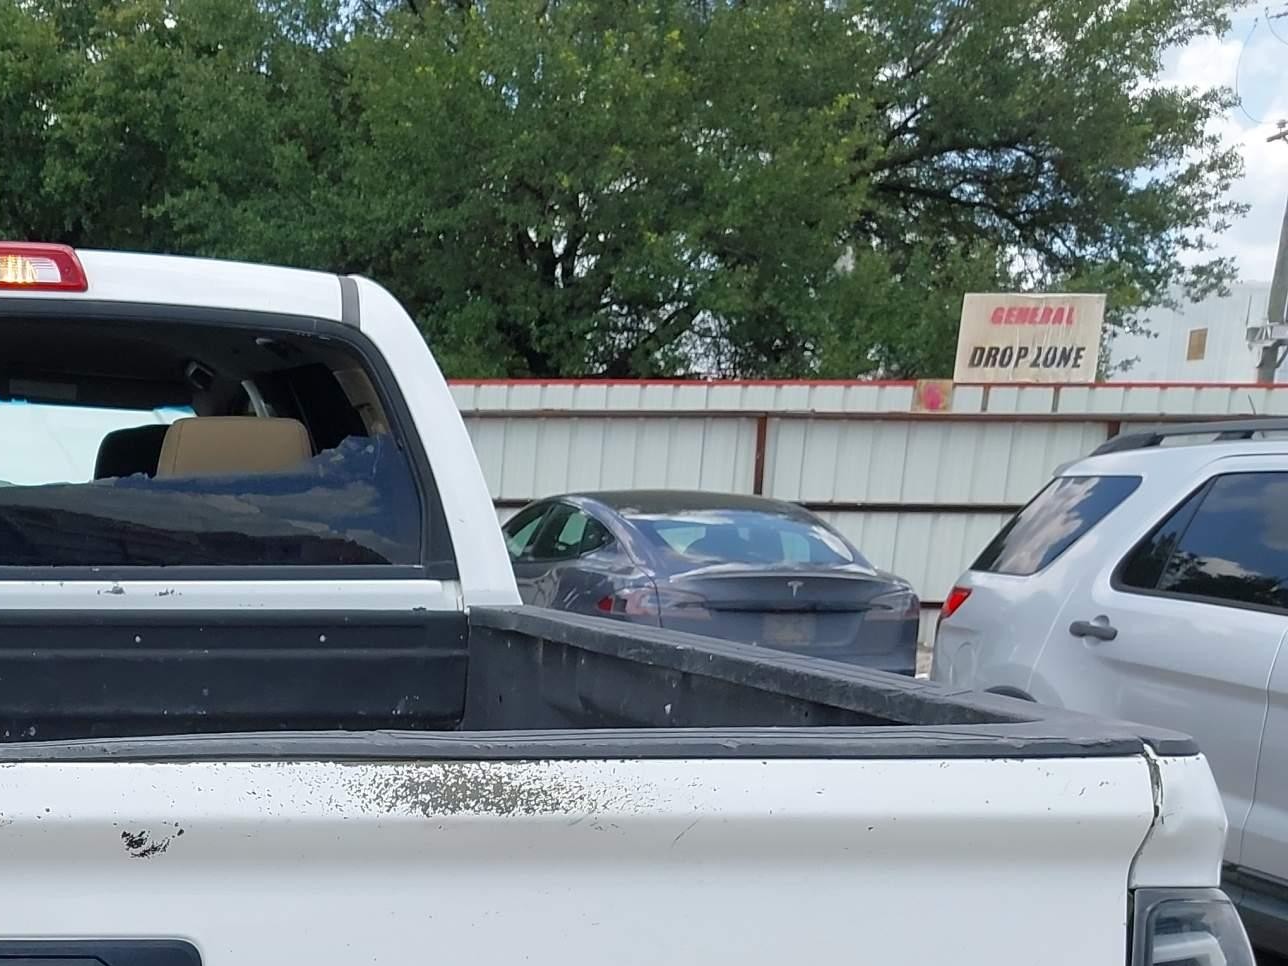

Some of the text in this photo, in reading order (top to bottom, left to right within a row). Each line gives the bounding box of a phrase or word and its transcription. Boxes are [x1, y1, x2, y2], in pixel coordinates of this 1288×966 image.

[990, 306, 1075, 326] GENERAL
[968, 346, 1086, 369] DROP ZONE
